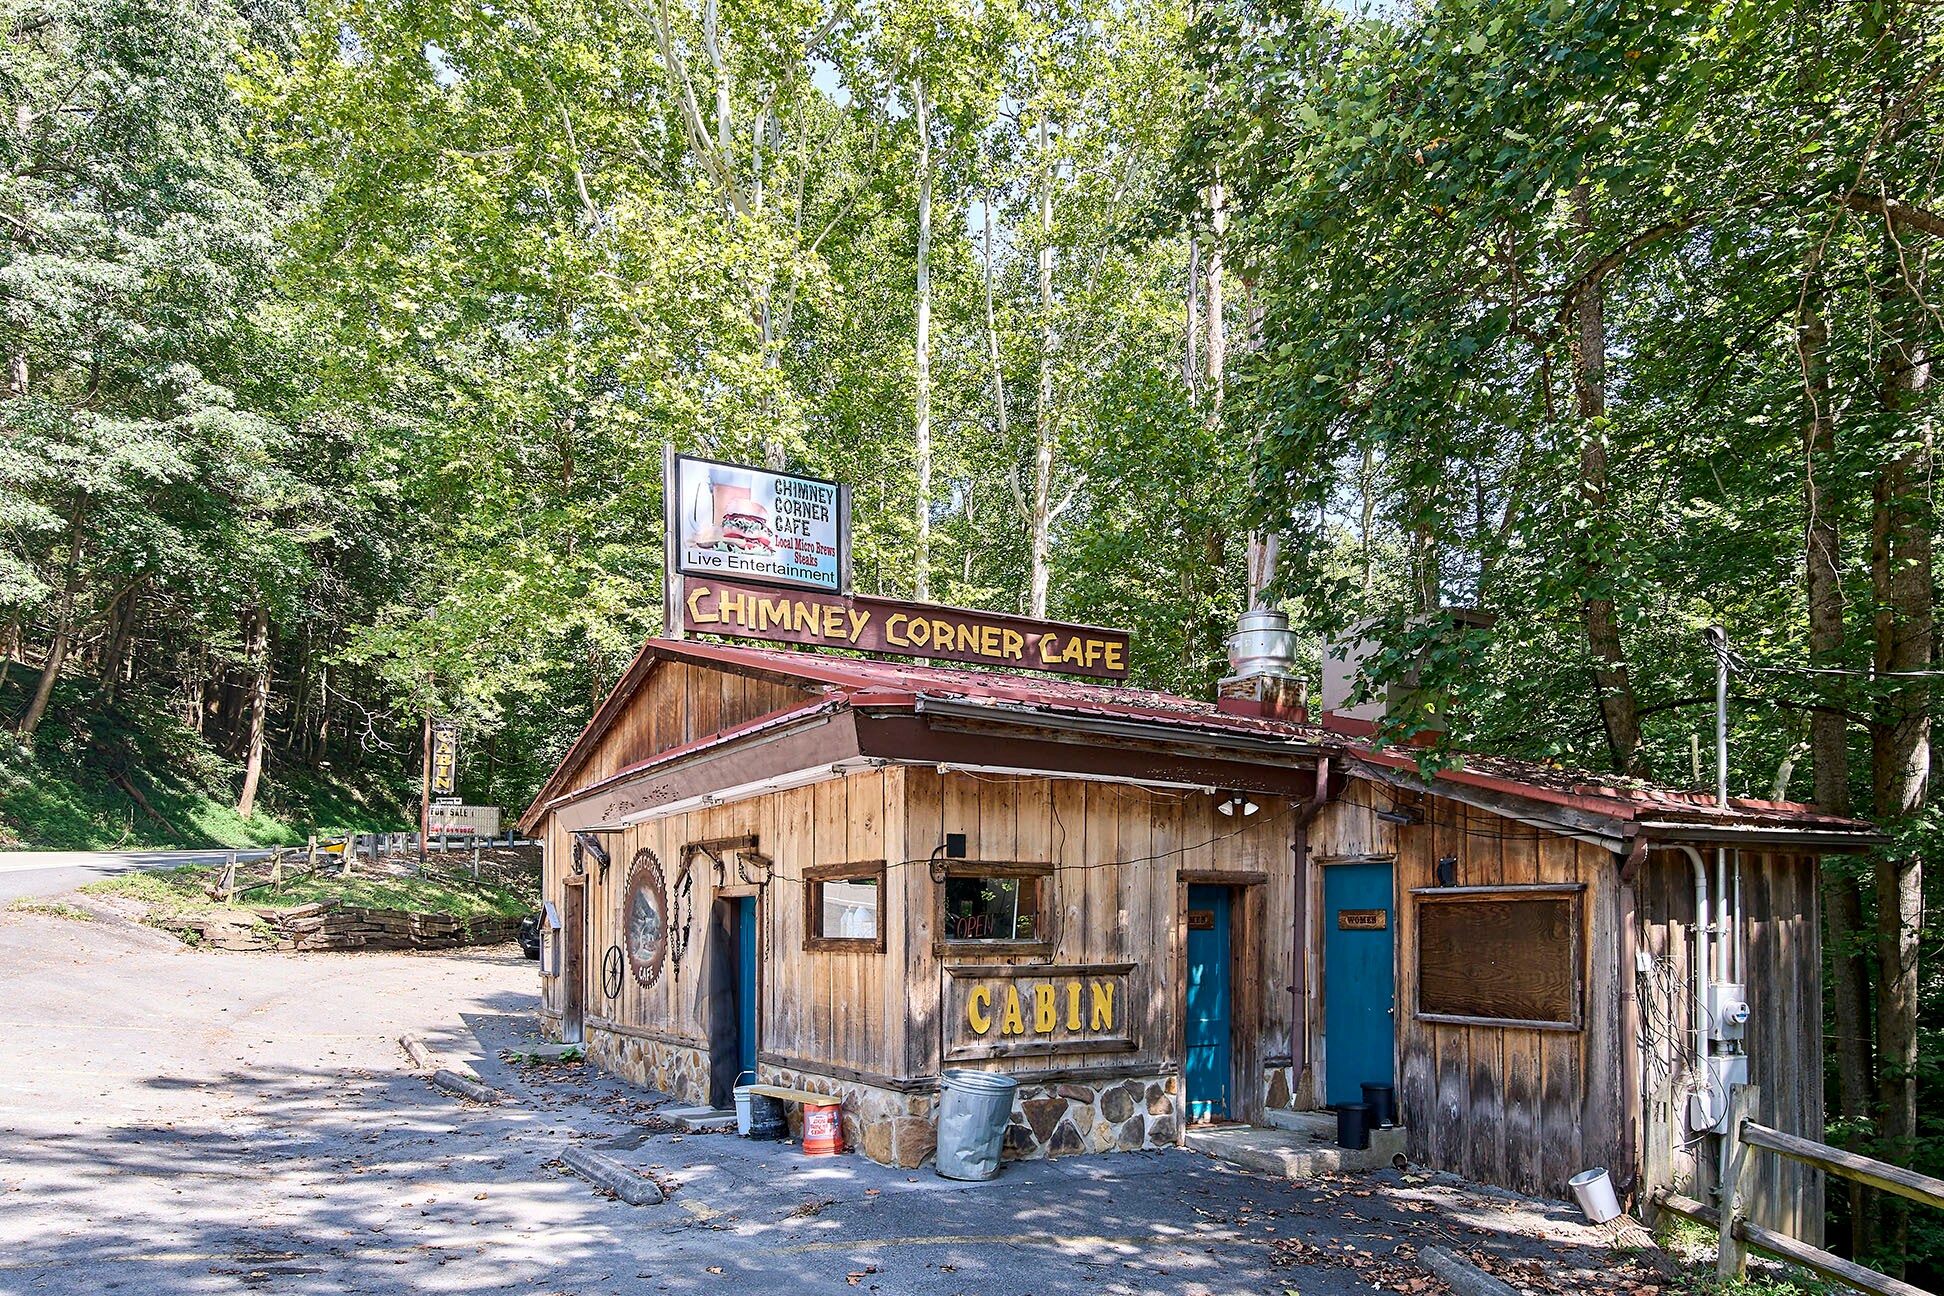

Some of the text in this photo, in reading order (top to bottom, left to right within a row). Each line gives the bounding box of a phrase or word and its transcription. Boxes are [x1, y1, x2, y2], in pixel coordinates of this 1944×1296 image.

[775, 478, 834, 505] CHIMNEY
[775, 496, 829, 523] CORNER
[775, 515, 811, 537] CAFE
[775, 535, 836, 557] Local Micro Brews
[794, 552, 818, 567] Steaks
[687, 551, 836, 583] Live Entertainment
[686, 586, 1125, 671] CHIMNEY CORNER CAFE
[434, 730, 454, 790] CABIN
[430, 807, 444, 816] FOR
[450, 808, 468, 817] SALE
[957, 913, 995, 940] OPEN
[1347, 916, 1377, 924] WOMEN
[639, 965, 654, 981] CAFE
[968, 982, 1115, 1035] CABIN
